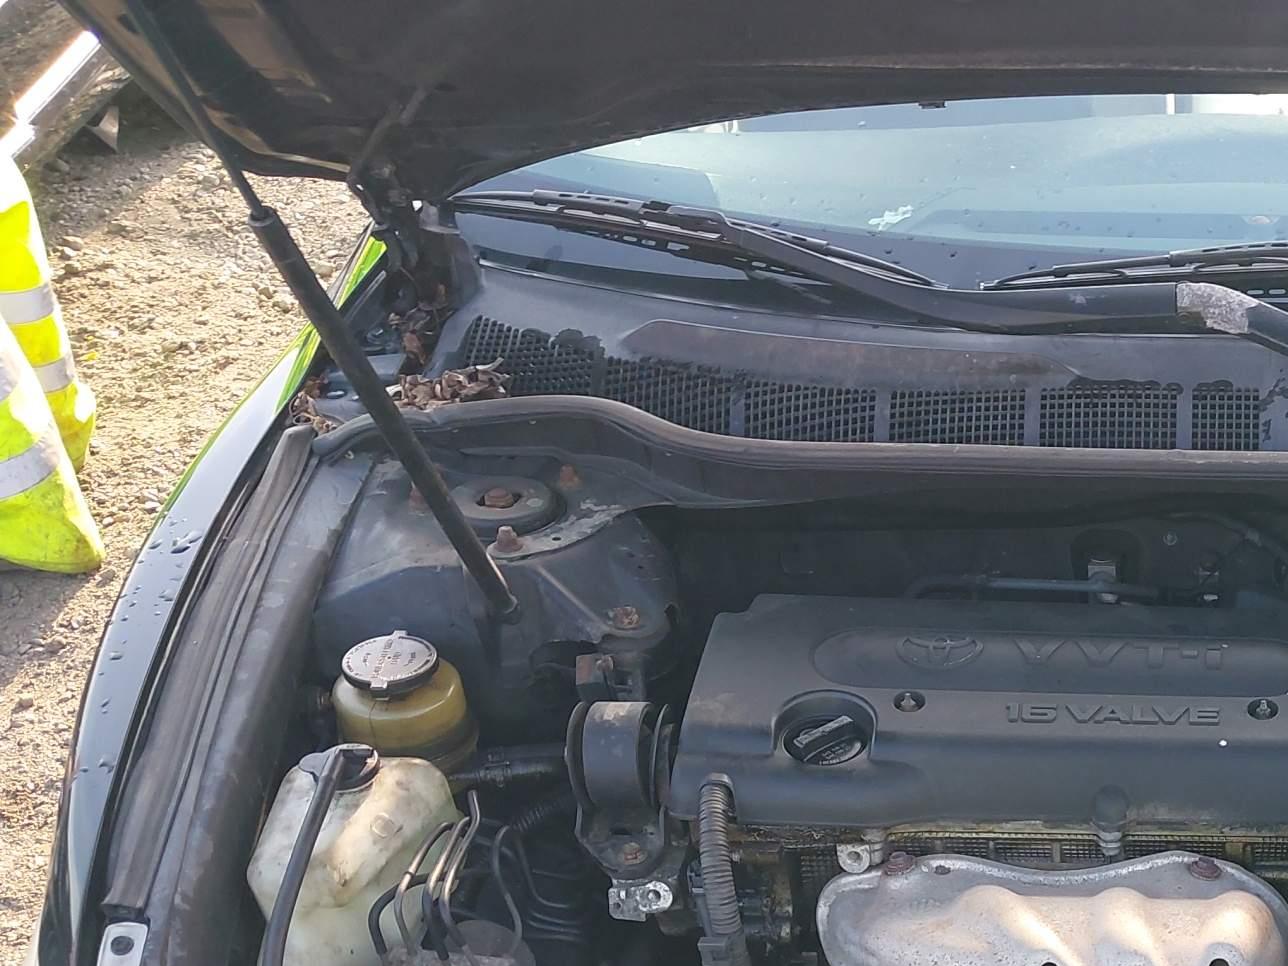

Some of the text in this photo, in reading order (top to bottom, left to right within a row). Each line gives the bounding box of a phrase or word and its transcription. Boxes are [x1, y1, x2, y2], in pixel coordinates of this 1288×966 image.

[1014, 639, 1224, 670] VVT-i
[1006, 703, 1223, 726] 16 VALVE
